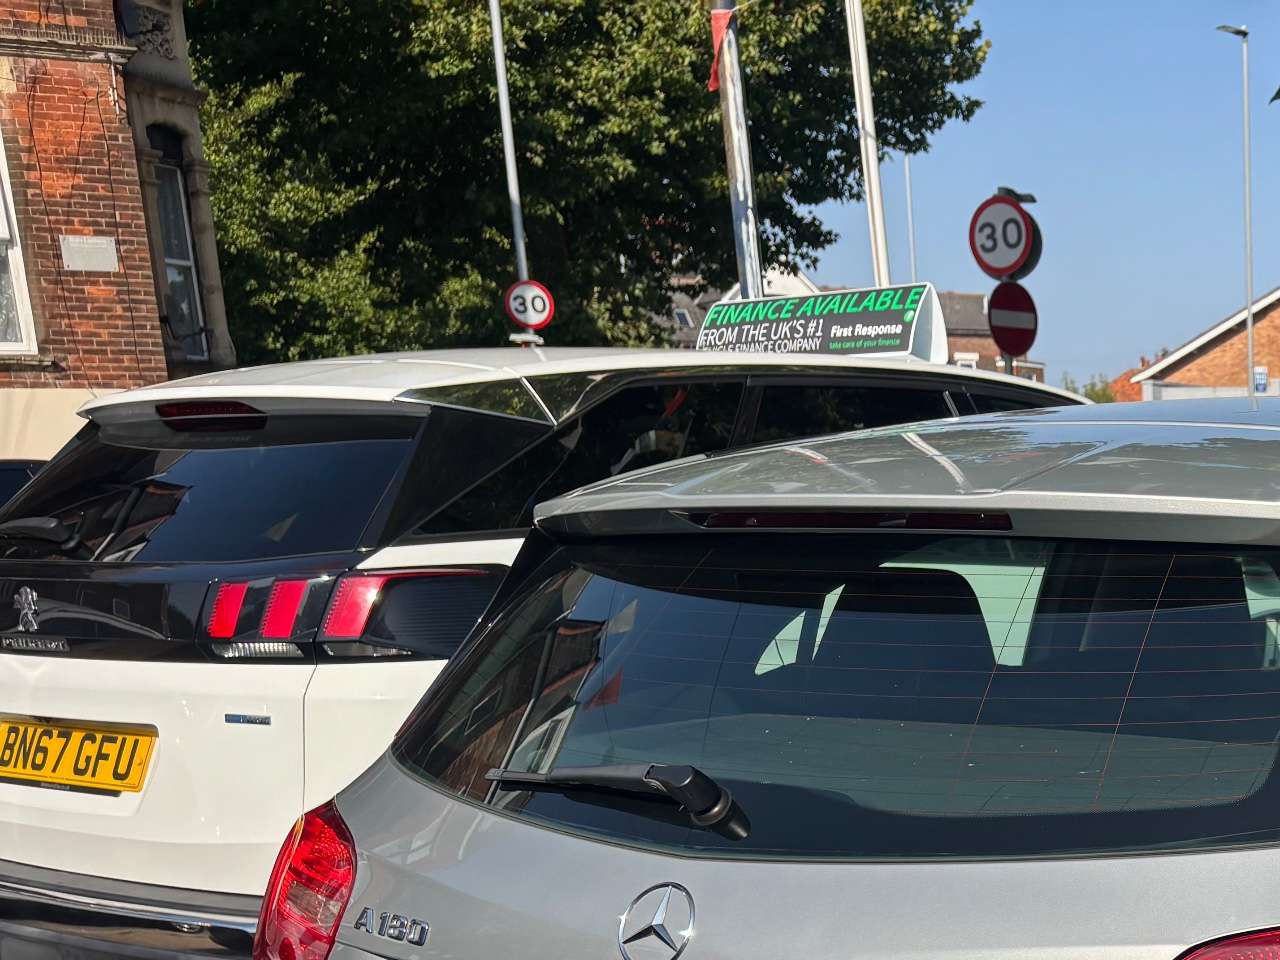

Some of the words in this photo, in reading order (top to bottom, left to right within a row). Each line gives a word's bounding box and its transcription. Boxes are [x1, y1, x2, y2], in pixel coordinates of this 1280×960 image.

[978, 218, 1023, 253] 30
[513, 295, 546, 313] 30
[705, 298, 795, 327] FINANCE
[796, 287, 925, 318] AVAILABLE
[700, 326, 739, 347] FROM
[742, 322, 770, 342] THE
[771, 318, 805, 340] UK'S
[806, 318, 824, 337] #1
[735, 340, 774, 353] FINANCE
[775, 337, 822, 353] COMPANY
[830, 325, 853, 338] First
[854, 323, 903, 338] Response
[0, 726, 71, 774] BN67
[73, 733, 140, 782] GFU
